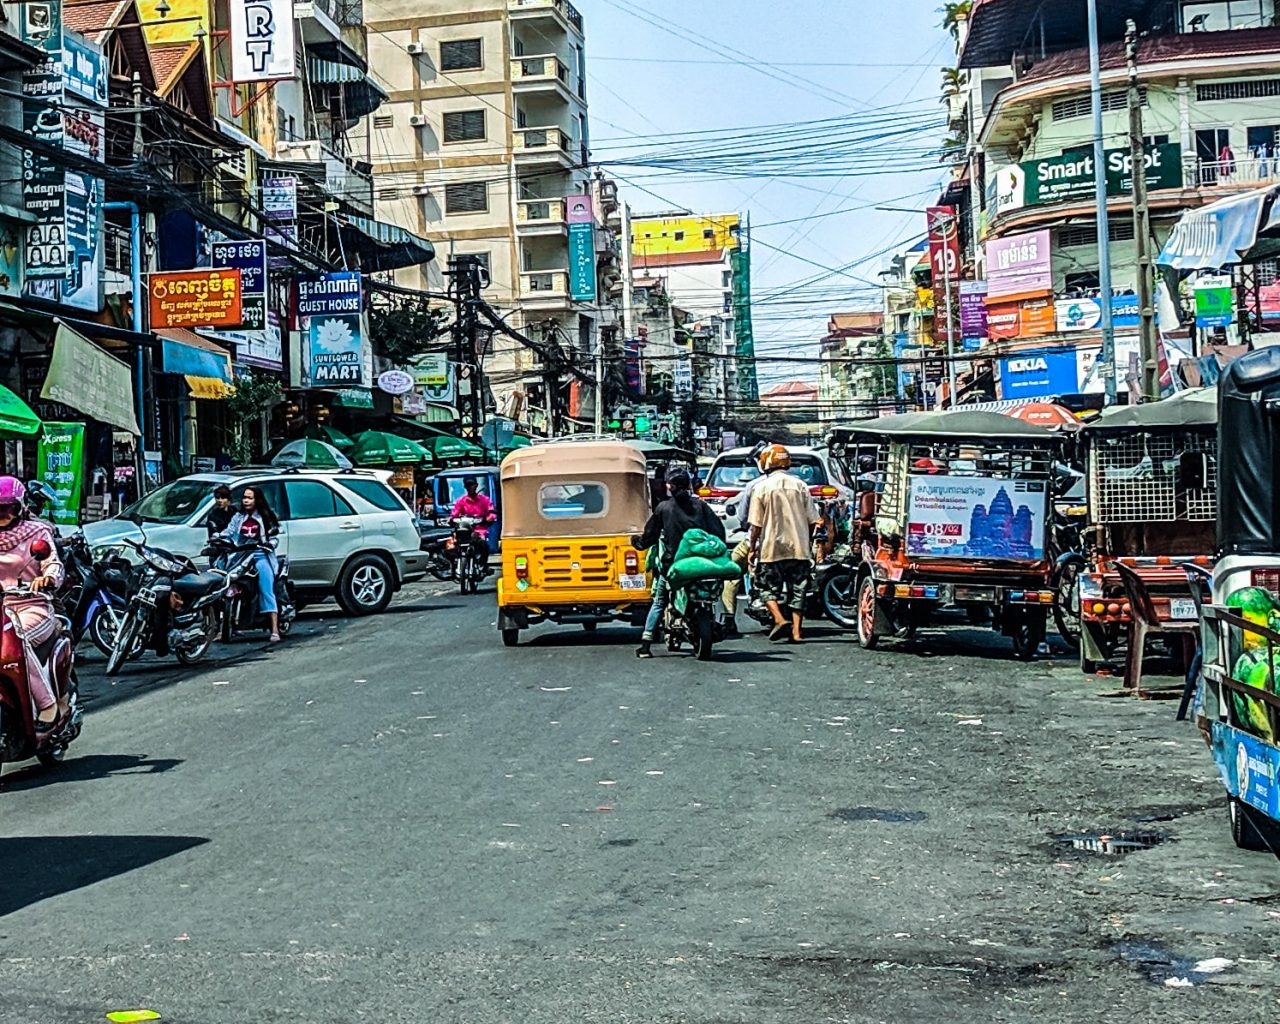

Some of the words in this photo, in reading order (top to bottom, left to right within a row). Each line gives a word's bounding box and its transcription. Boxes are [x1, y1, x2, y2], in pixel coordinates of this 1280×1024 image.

[1038, 155, 1094, 181] Smart
[934, 249, 957, 273] 19
[299, 300, 326, 312] GUEST
[328, 298, 359, 311] HOUSE
[314, 352, 359, 364] SUNFLOWER
[316, 365, 359, 380] MART
